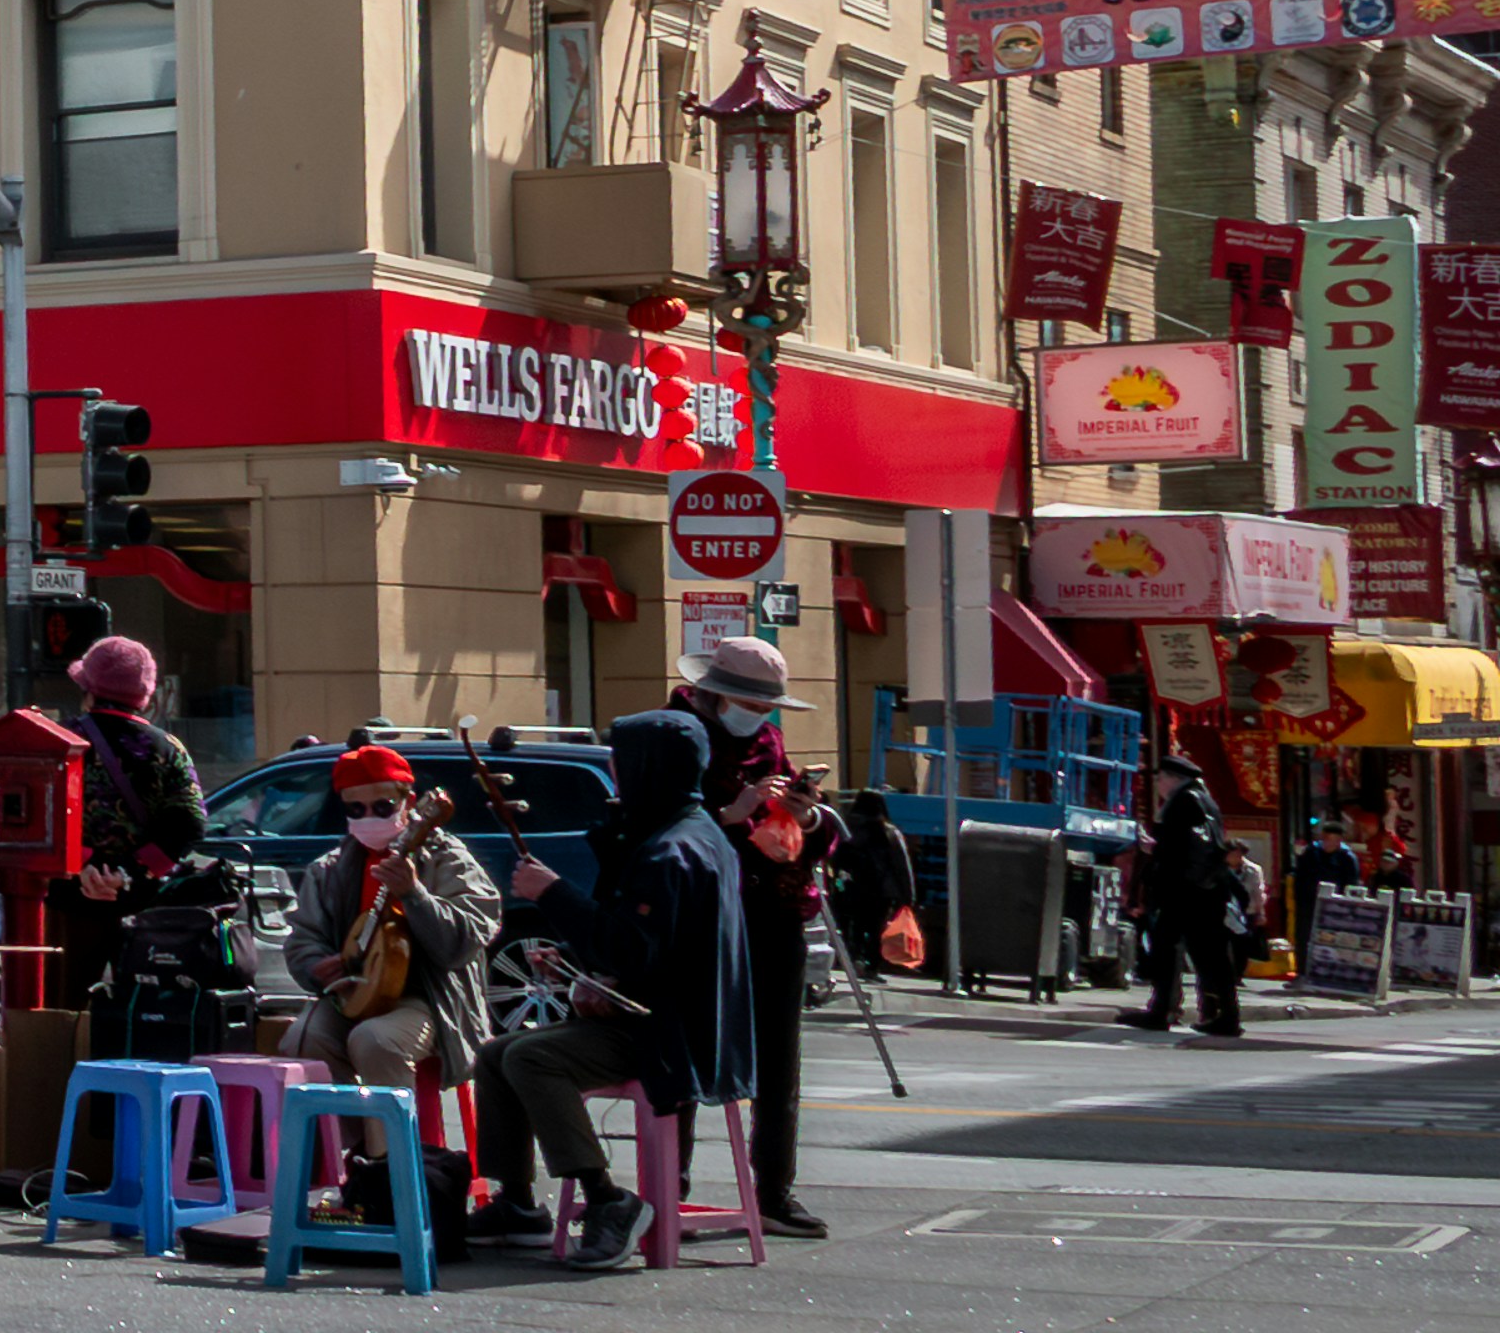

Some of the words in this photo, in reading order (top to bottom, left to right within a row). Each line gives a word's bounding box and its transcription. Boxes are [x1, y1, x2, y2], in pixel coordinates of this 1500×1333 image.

[1323, 236, 1400, 476] ZODIAC
[405, 328, 543, 423] WELLS
[550, 353, 662, 439] FARGO
[1078, 419, 1150, 435] IMPERIAL
[1155, 417, 1199, 433] FRUIT
[687, 493, 714, 510] DO
[724, 493, 765, 511] NOT
[1315, 485, 1413, 502] STATION
[691, 541, 762, 558] ENTER
[1368, 560, 1428, 574] HISTORY
[36, 572, 77, 589] GRANT
[1368, 580, 1429, 593] CULTURE
[687, 593, 742, 603] TOW-AWAY
[1057, 583, 1134, 599] IMPERIAL
[1140, 582, 1186, 598] FRUIT
[683, 604, 700, 620] NO
[702, 623, 728, 635] ANY
